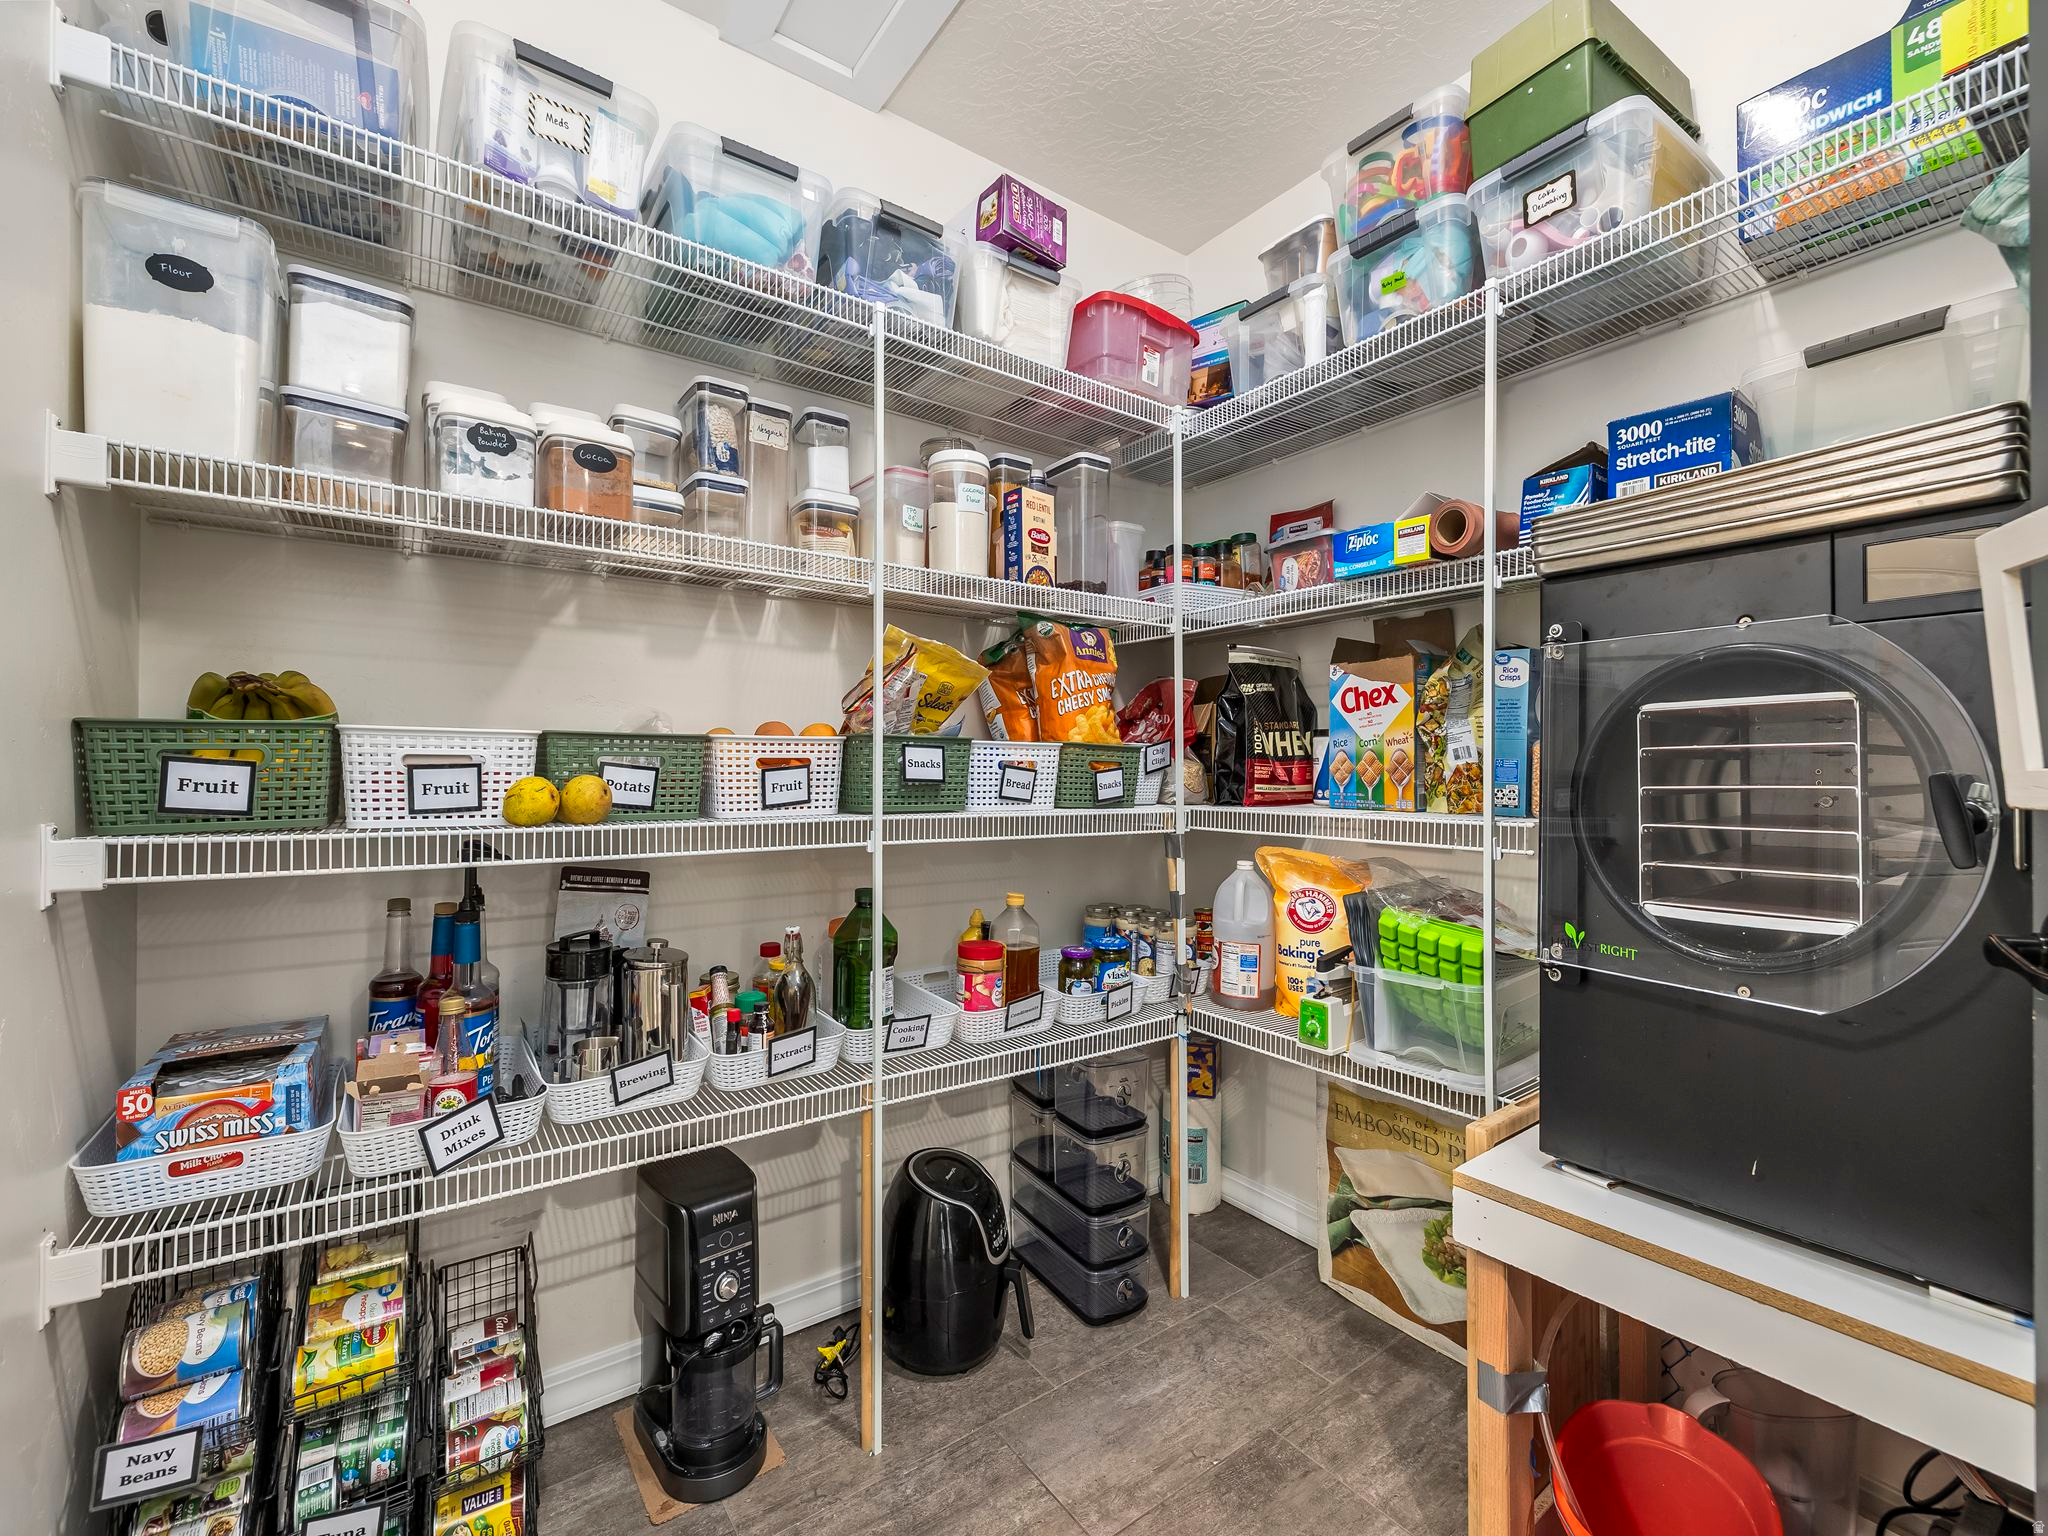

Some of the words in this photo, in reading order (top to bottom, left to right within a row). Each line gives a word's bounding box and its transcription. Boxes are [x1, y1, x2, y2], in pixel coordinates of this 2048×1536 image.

[1803, 88, 1882, 133] NDWICH
[545, 113, 569, 130] Meds
[1011, 182, 1021, 224] SOLO
[1532, 192, 1567, 213] Decorating
[159, 262, 192, 279] Flour
[1733, 404, 1748, 430] 3000
[479, 426, 507, 442] Baking
[1616, 419, 1662, 445] 3000
[477, 436, 511, 449] Powder
[1617, 440, 1643, 451] SQUARE
[1645, 435, 1661, 445] FEET
[579, 449, 611, 464] Cocoa
[1616, 434, 1716, 471] stretch-tite
[1539, 474, 1569, 486] KIRKLAND
[1659, 465, 1717, 486] KIRKLAND
[1026, 500, 1036, 510] RED
[1036, 502, 1052, 515] LENTIL
[1523, 496, 1554, 506] Foodservice
[1030, 530, 1049, 542] Barilla
[1399, 525, 1425, 536] KIRKLAND
[1347, 532, 1379, 552] Ziploc
[1076, 644, 1105, 661] Annie's
[1499, 674, 1521, 682] Crisps
[1502, 666, 1519, 674] Rice
[1051, 669, 1093, 700] EXTRA
[917, 692, 953, 713] Selects
[1057, 691, 1095, 716] CHEESY
[1341, 683, 1399, 714] Chex
[1262, 731, 1312, 757] WHEY
[1332, 738, 1349, 749] Rice
[1358, 738, 1377, 748] Corn
[1385, 736, 1409, 748] Wheat
[1152, 747, 1165, 757] Chip
[907, 757, 942, 770] Snacks
[1151, 756, 1166, 766] Clips
[177, 777, 239, 796] Fruit
[421, 780, 470, 797] Fruit
[606, 778, 651, 795] Potats
[771, 779, 803, 794] Fruit
[1005, 778, 1031, 791] Bread
[1098, 779, 1123, 792] Snacks
[1305, 889, 1334, 914] HAMMER
[1300, 939, 1321, 949] pure
[1600, 943, 1638, 961] RIGHT
[1278, 944, 1315, 963] Baking
[1287, 976, 1304, 985] 100+
[1287, 984, 1304, 993] USES
[1110, 996, 1129, 1009] Pickles
[1010, 1005, 1039, 1018] Condiments
[892, 1023, 925, 1035] Cooking
[899, 1035, 915, 1044] Oils
[773, 1042, 812, 1062] Extracts
[619, 1066, 667, 1089] Brewing
[122, 1093, 153, 1116] 50
[440, 1113, 481, 1142] Drink
[1335, 1102, 1440, 1156] EMBOSSED
[1393, 1112, 1410, 1124] SET
[1415, 1120, 1430, 1131] OF
[154, 1122, 219, 1153] SWISS
[224, 1111, 274, 1138] MISS
[444, 1128, 486, 1157] Mixes
[180, 1159, 202, 1171] Milk
[712, 1209, 739, 1227] NINJA
[195, 1327, 205, 1356] Beans
[341, 1341, 350, 1360] Pears
[126, 1447, 176, 1468] Navy
[119, 1465, 178, 1487] Beans
[463, 1489, 495, 1512] VALUE
